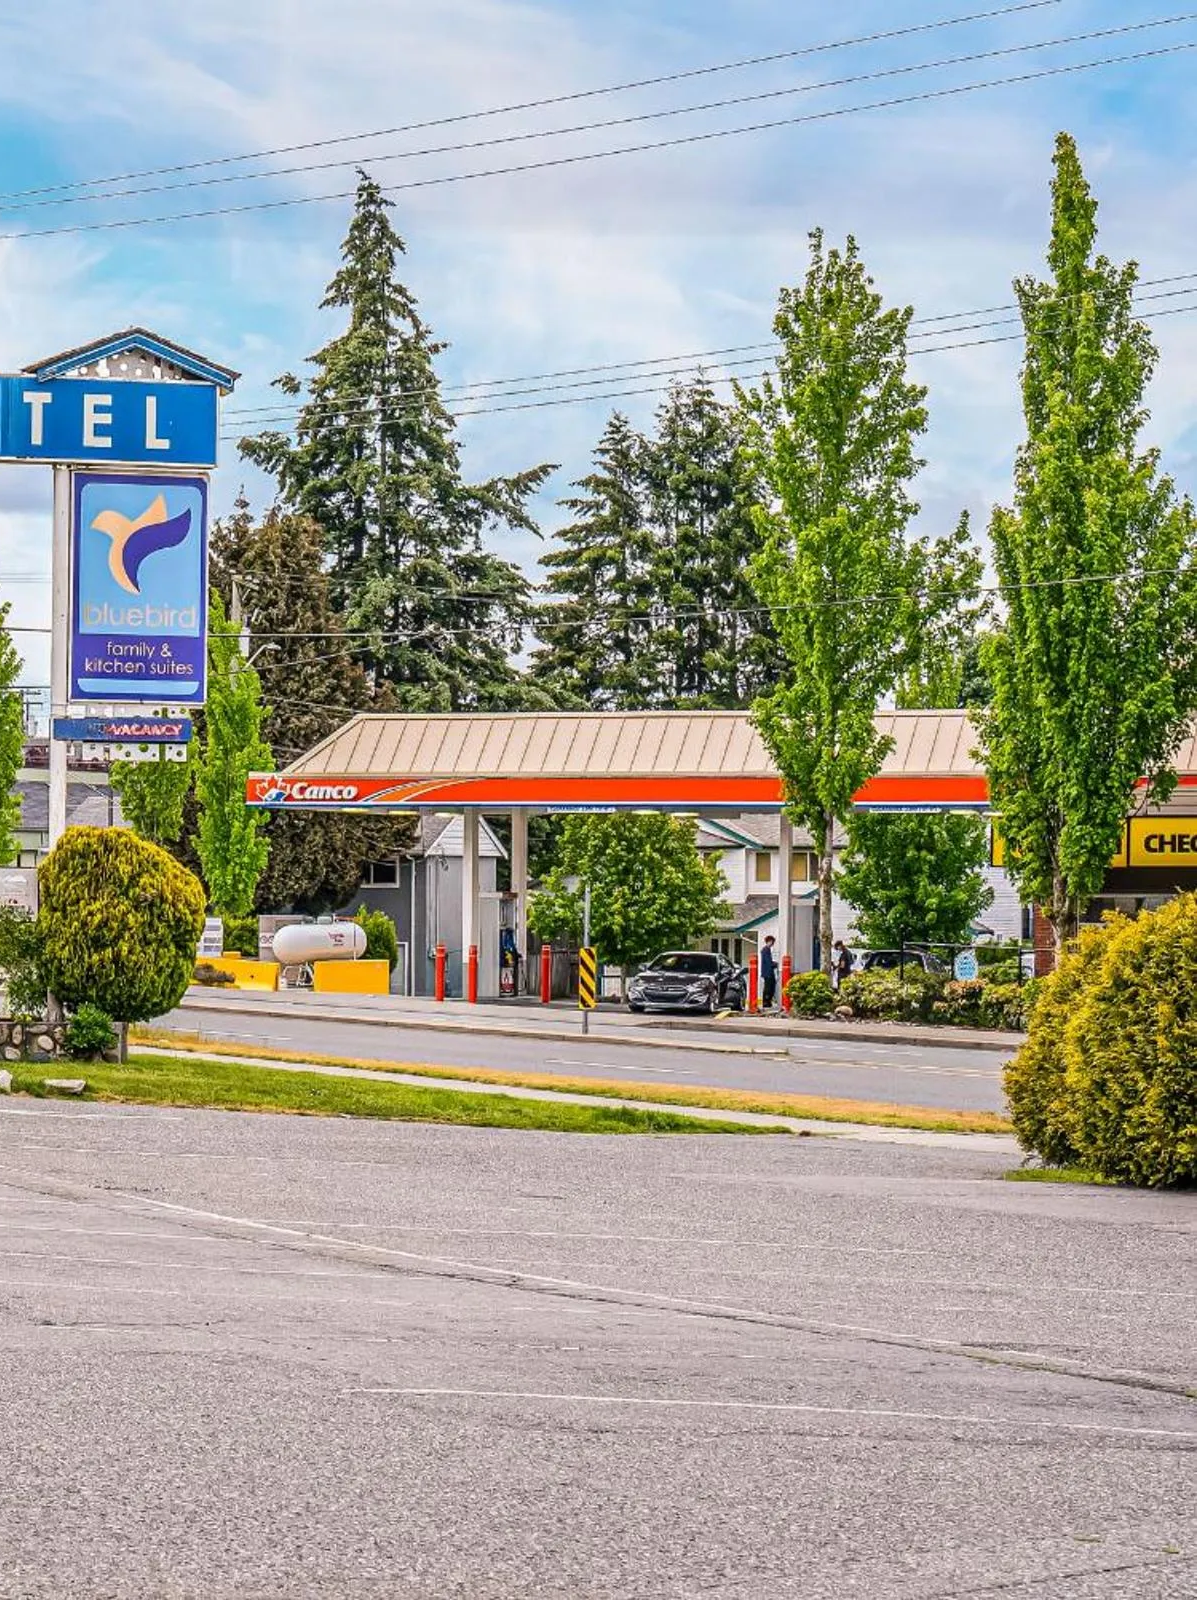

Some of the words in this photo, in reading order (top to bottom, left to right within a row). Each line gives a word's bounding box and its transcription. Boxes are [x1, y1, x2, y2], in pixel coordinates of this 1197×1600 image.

[84, 601, 196, 629] bluebird
[107, 641, 155, 658] family
[160, 642, 172, 658] &
[85, 657, 145, 673] kitchen
[150, 660, 193, 675] suites
[107, 723, 182, 735] VACANCY
[291, 782, 358, 799] Canco
